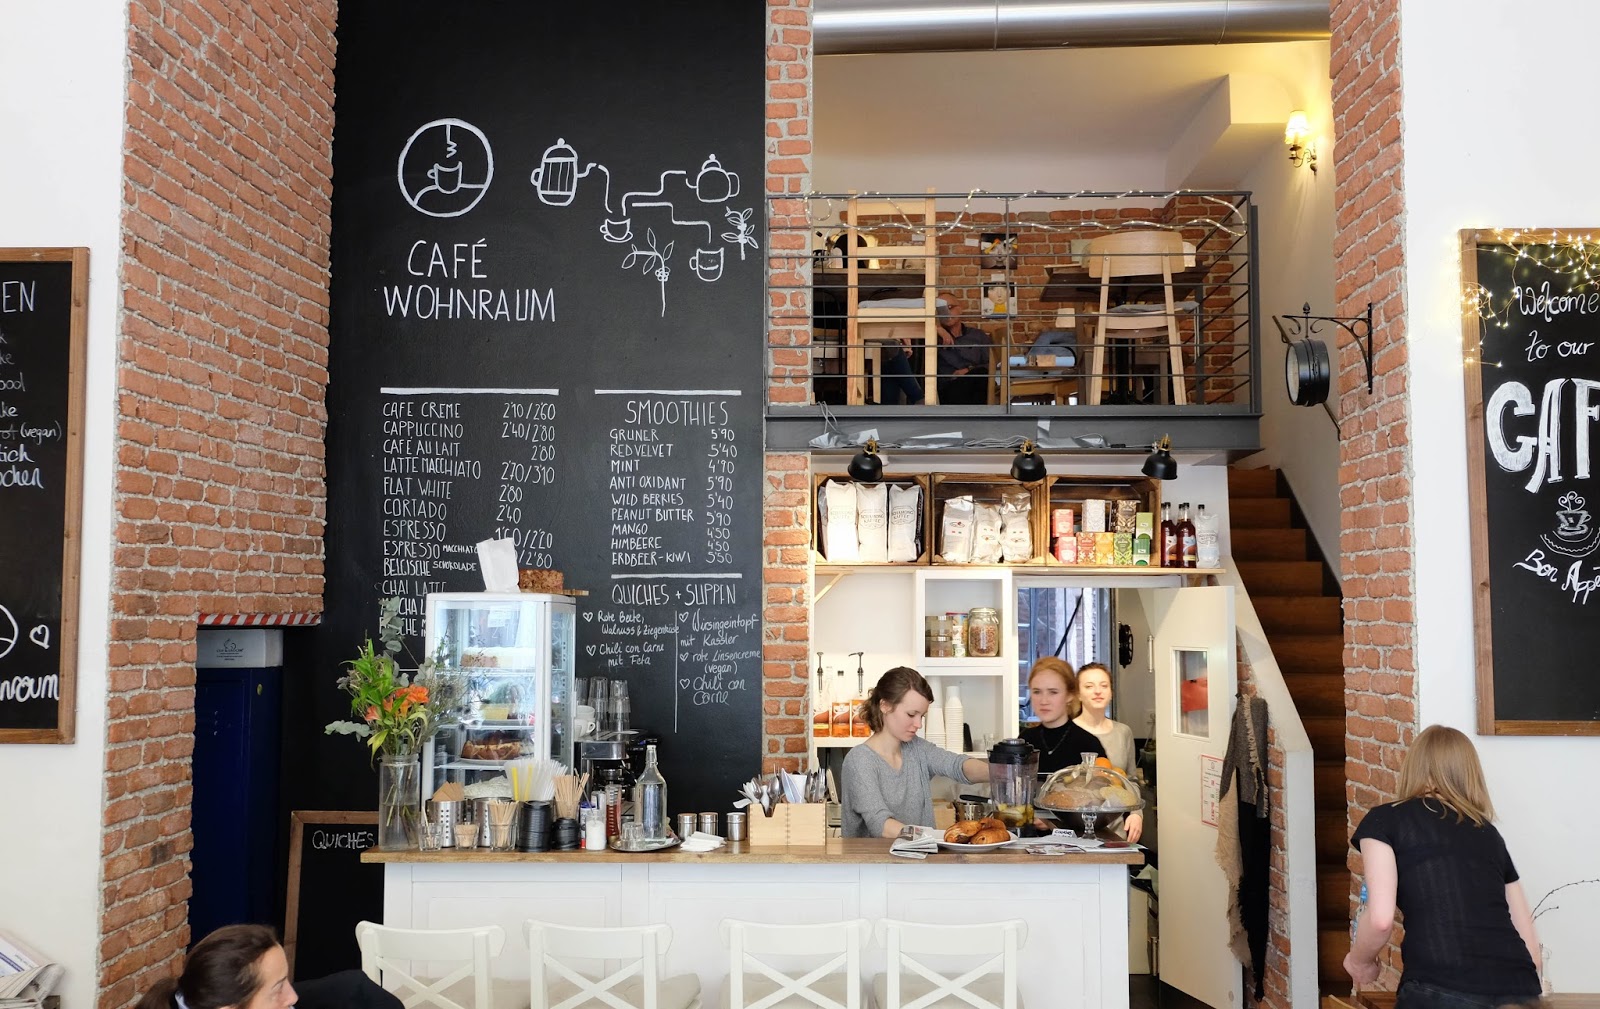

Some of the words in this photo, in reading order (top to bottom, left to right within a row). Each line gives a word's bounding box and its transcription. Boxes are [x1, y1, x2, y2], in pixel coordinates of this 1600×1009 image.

[408, 238, 487, 278] CAFÉ
[384, 285, 555, 322] WOHNRAUM
[1513, 278, 1600, 322] Welcome
[1525, 330, 1551, 362] to
[1557, 341, 1594, 357] our
[383, 402, 413, 419] CAFE
[422, 402, 460, 419] CREME
[625, 400, 728, 426] SMOOTHIES
[20, 421, 61, 446] (vegan)
[384, 421, 463, 439] CAPPUCCINO
[610, 429, 659, 445] GRUNER
[384, 435, 412, 454] CAFÉ
[416, 440, 431, 455] AU
[436, 441, 460, 457] LAIT
[635, 444, 673, 457] VELVET
[384, 457, 418, 473] LATTE
[421, 457, 482, 480] MACCHIATO
[612, 460, 639, 473] MINT
[384, 477, 412, 495] FLAT
[418, 479, 452, 499] WHITE
[610, 476, 635, 490] ANTI
[640, 477, 686, 490] OXIDANT
[612, 493, 637, 506] WILD
[643, 493, 683, 506] BERRIES
[384, 498, 448, 521] CORTADO
[612, 508, 652, 520] PEANUT
[656, 509, 694, 522] BUTTER
[384, 519, 446, 543] ESPRESSO
[612, 523, 648, 535] MANGO
[384, 540, 442, 560] ESPRESSO
[611, 537, 662, 550] HIMBEERE
[384, 557, 431, 576] BELGISCHE
[433, 561, 476, 571] SCHOKOLADE
[1513, 548, 1558, 582] Bon
[382, 580, 408, 595] CHAI
[612, 584, 669, 605] QUICHES
[685, 584, 735, 606] SUPPEN
[598, 610, 615, 622] Rote
[692, 608, 759, 638] Wirsingeintopf
[602, 624, 635, 635] Walnuss
[681, 635, 695, 646] mit
[703, 633, 738, 646] Kassler
[600, 642, 622, 656] Chili
[626, 645, 640, 653] con
[693, 653, 708, 662] rote
[712, 650, 760, 663] Linsencreme
[608, 655, 623, 667] mit
[630, 654, 651, 665] Feta
[693, 676, 723, 692] Chili
[728, 680, 746, 690] con
[313, 830, 376, 850] QUICHES
